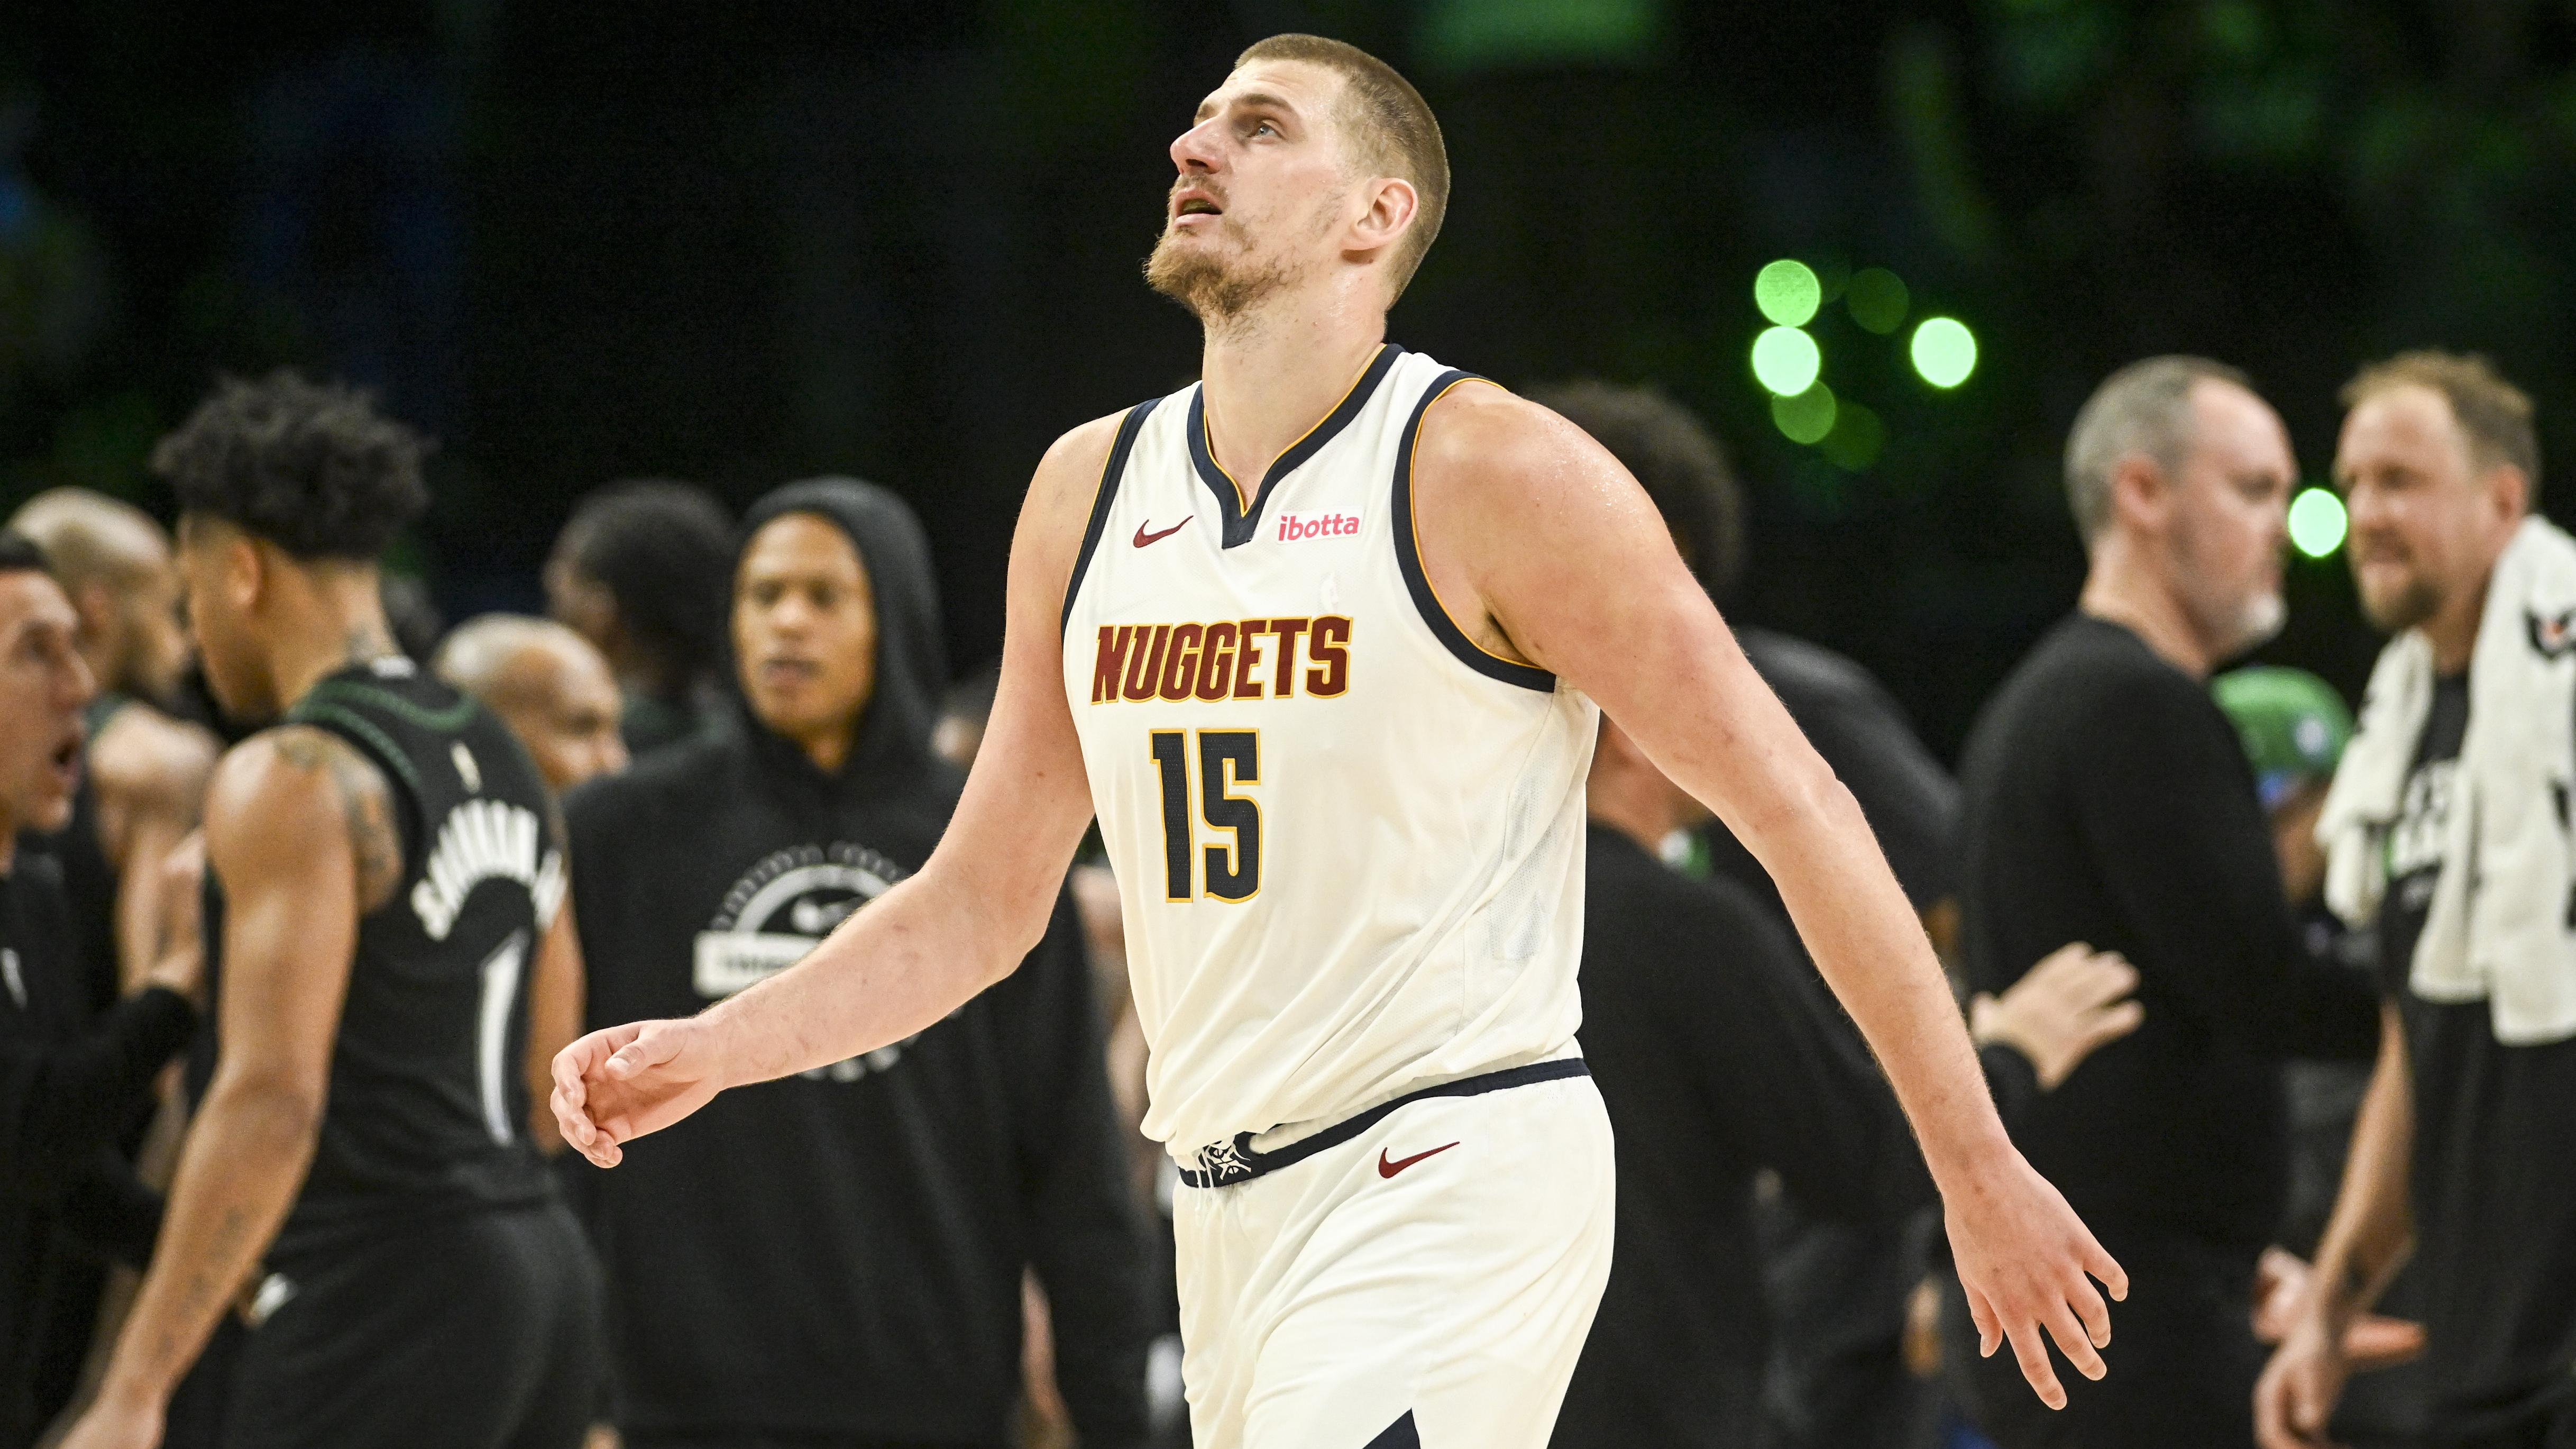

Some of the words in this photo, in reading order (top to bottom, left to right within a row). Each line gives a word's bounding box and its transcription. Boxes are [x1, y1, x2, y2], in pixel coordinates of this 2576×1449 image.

[1278, 513, 1360, 541] ibotta
[1091, 614, 1354, 705] NUGGETS
[1149, 727, 1263, 904] 15
